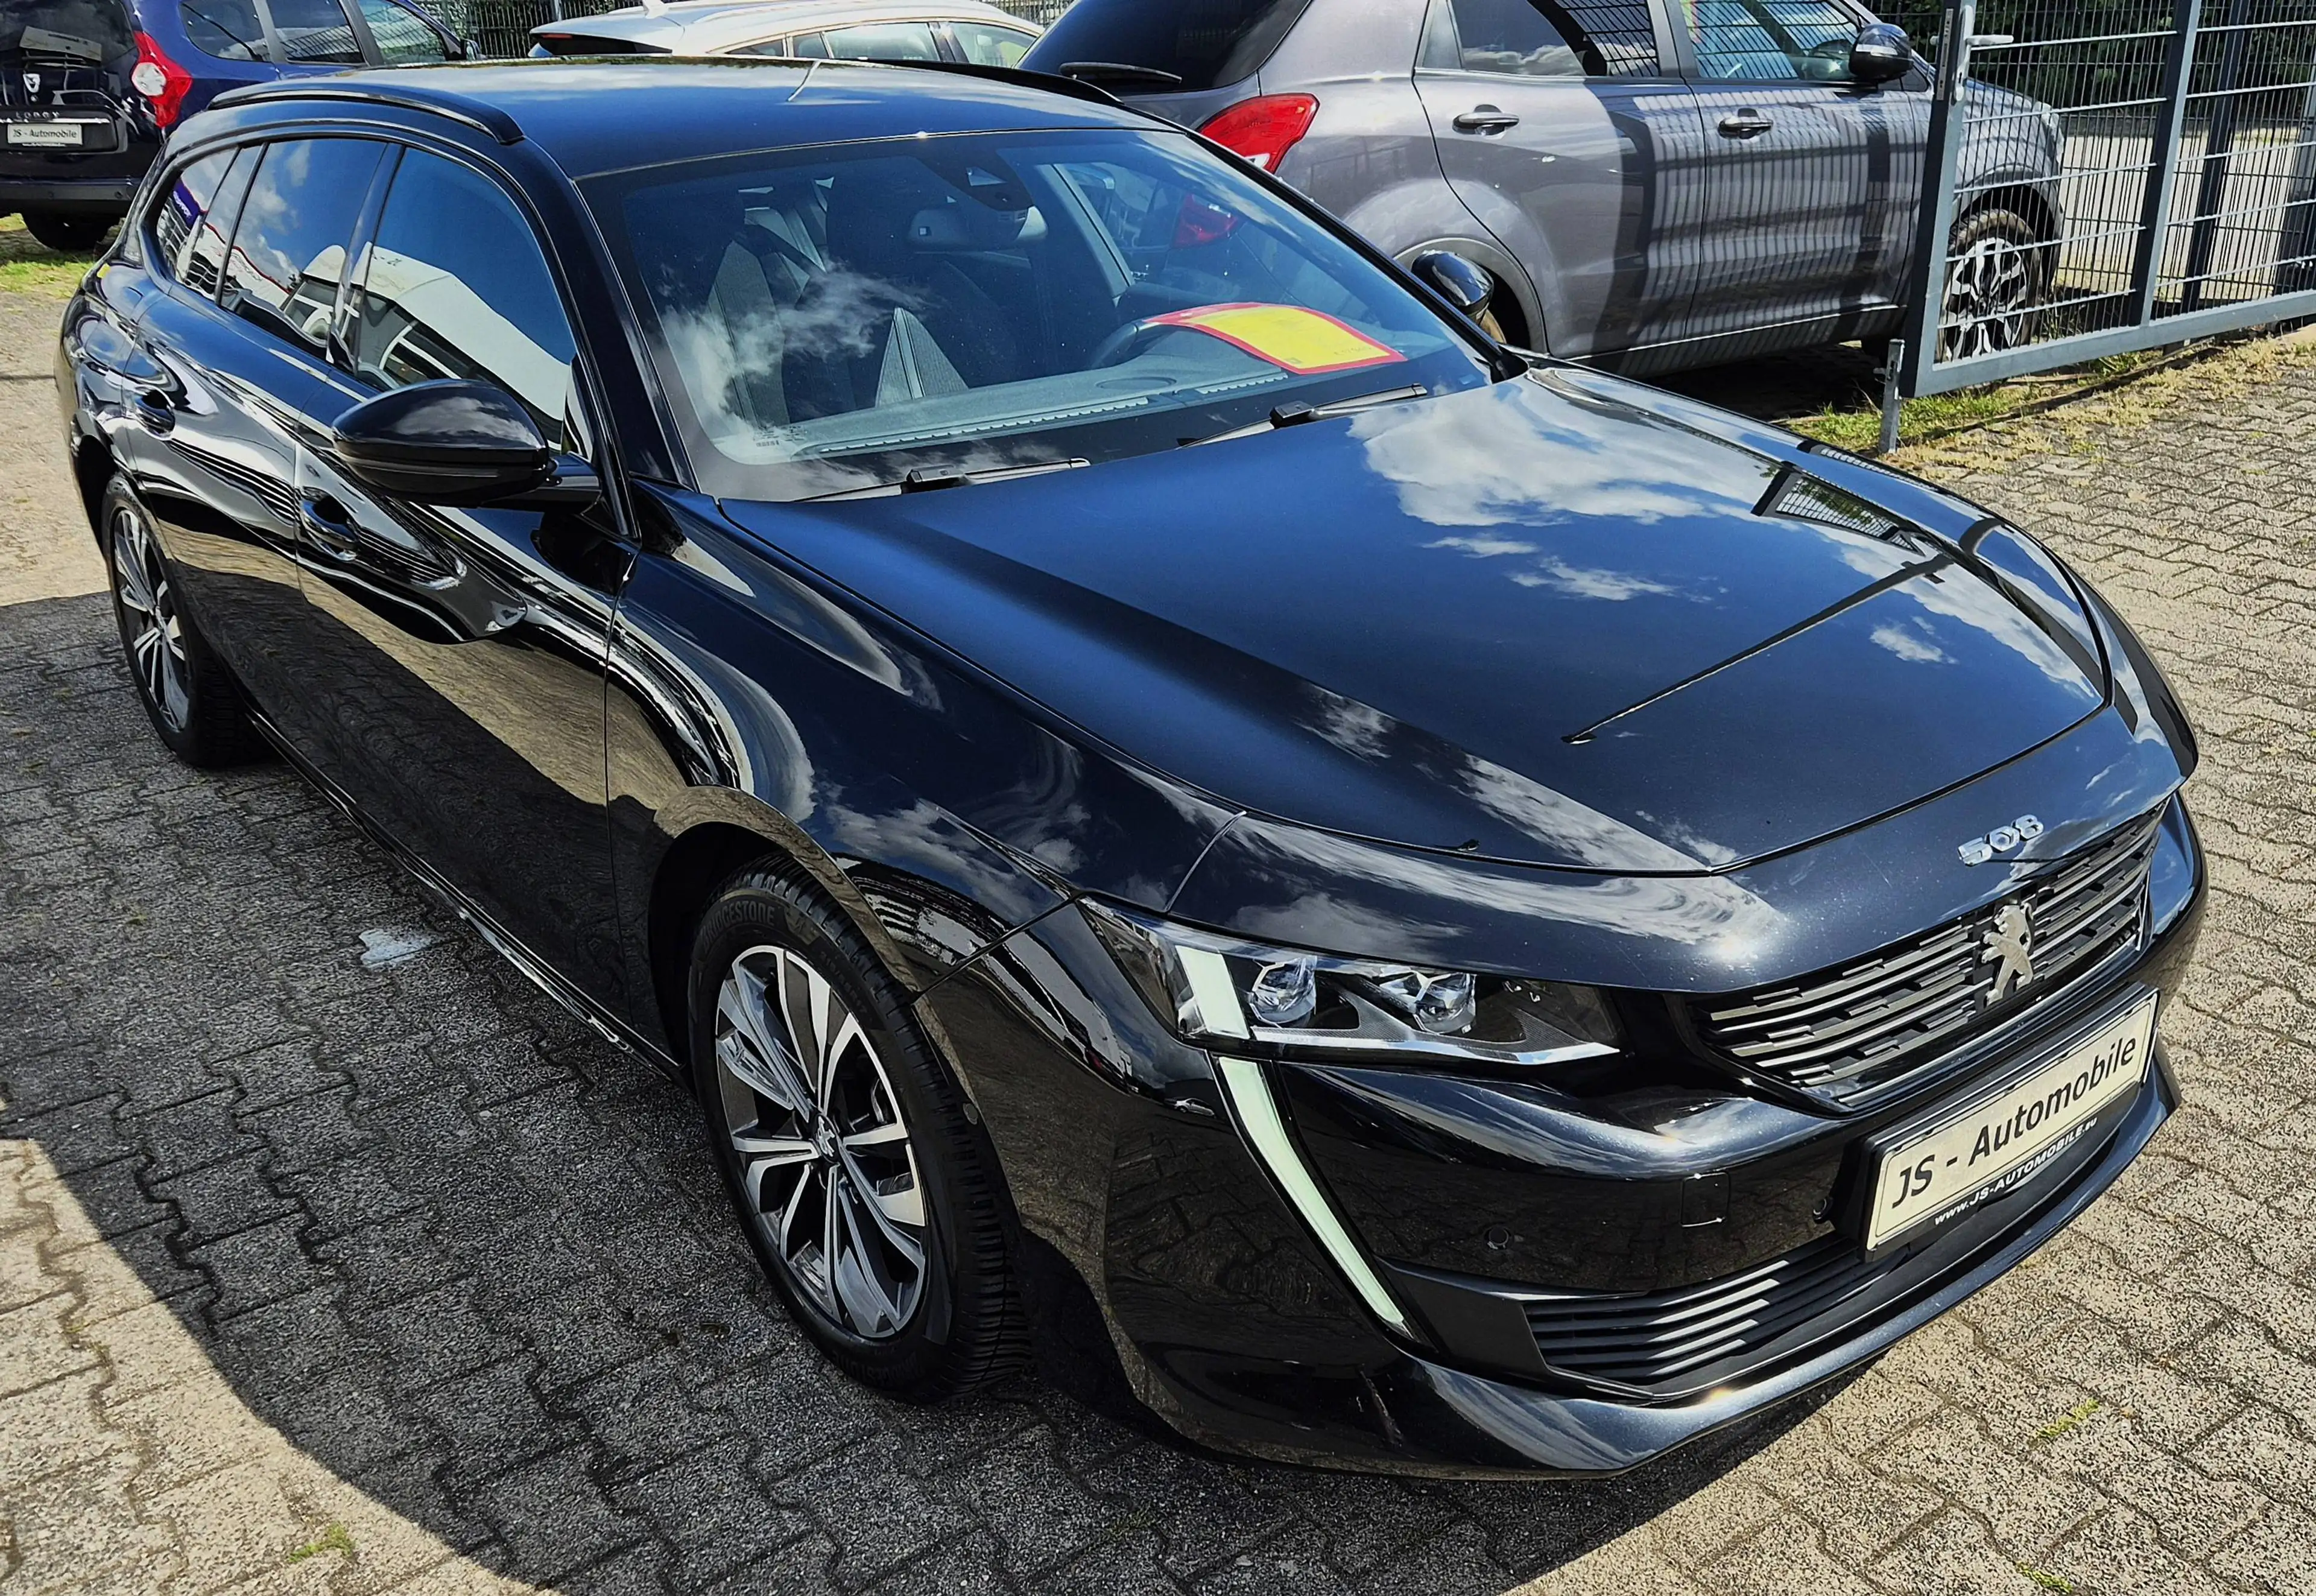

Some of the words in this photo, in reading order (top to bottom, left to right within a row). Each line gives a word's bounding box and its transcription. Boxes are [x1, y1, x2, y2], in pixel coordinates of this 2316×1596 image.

[13, 128, 22, 138] JS
[30, 128, 77, 138] Automobile
[1958, 814, 2044, 867] 508
[698, 901, 775, 954] BRIDGESTONE
[1892, 1153, 1936, 1209] JS
[1946, 1156, 1958, 1168] -
[1967, 1036, 2136, 1167] Automobile
[1935, 1117, 2098, 1226] www.JS-AUTOMOBILE.eu
